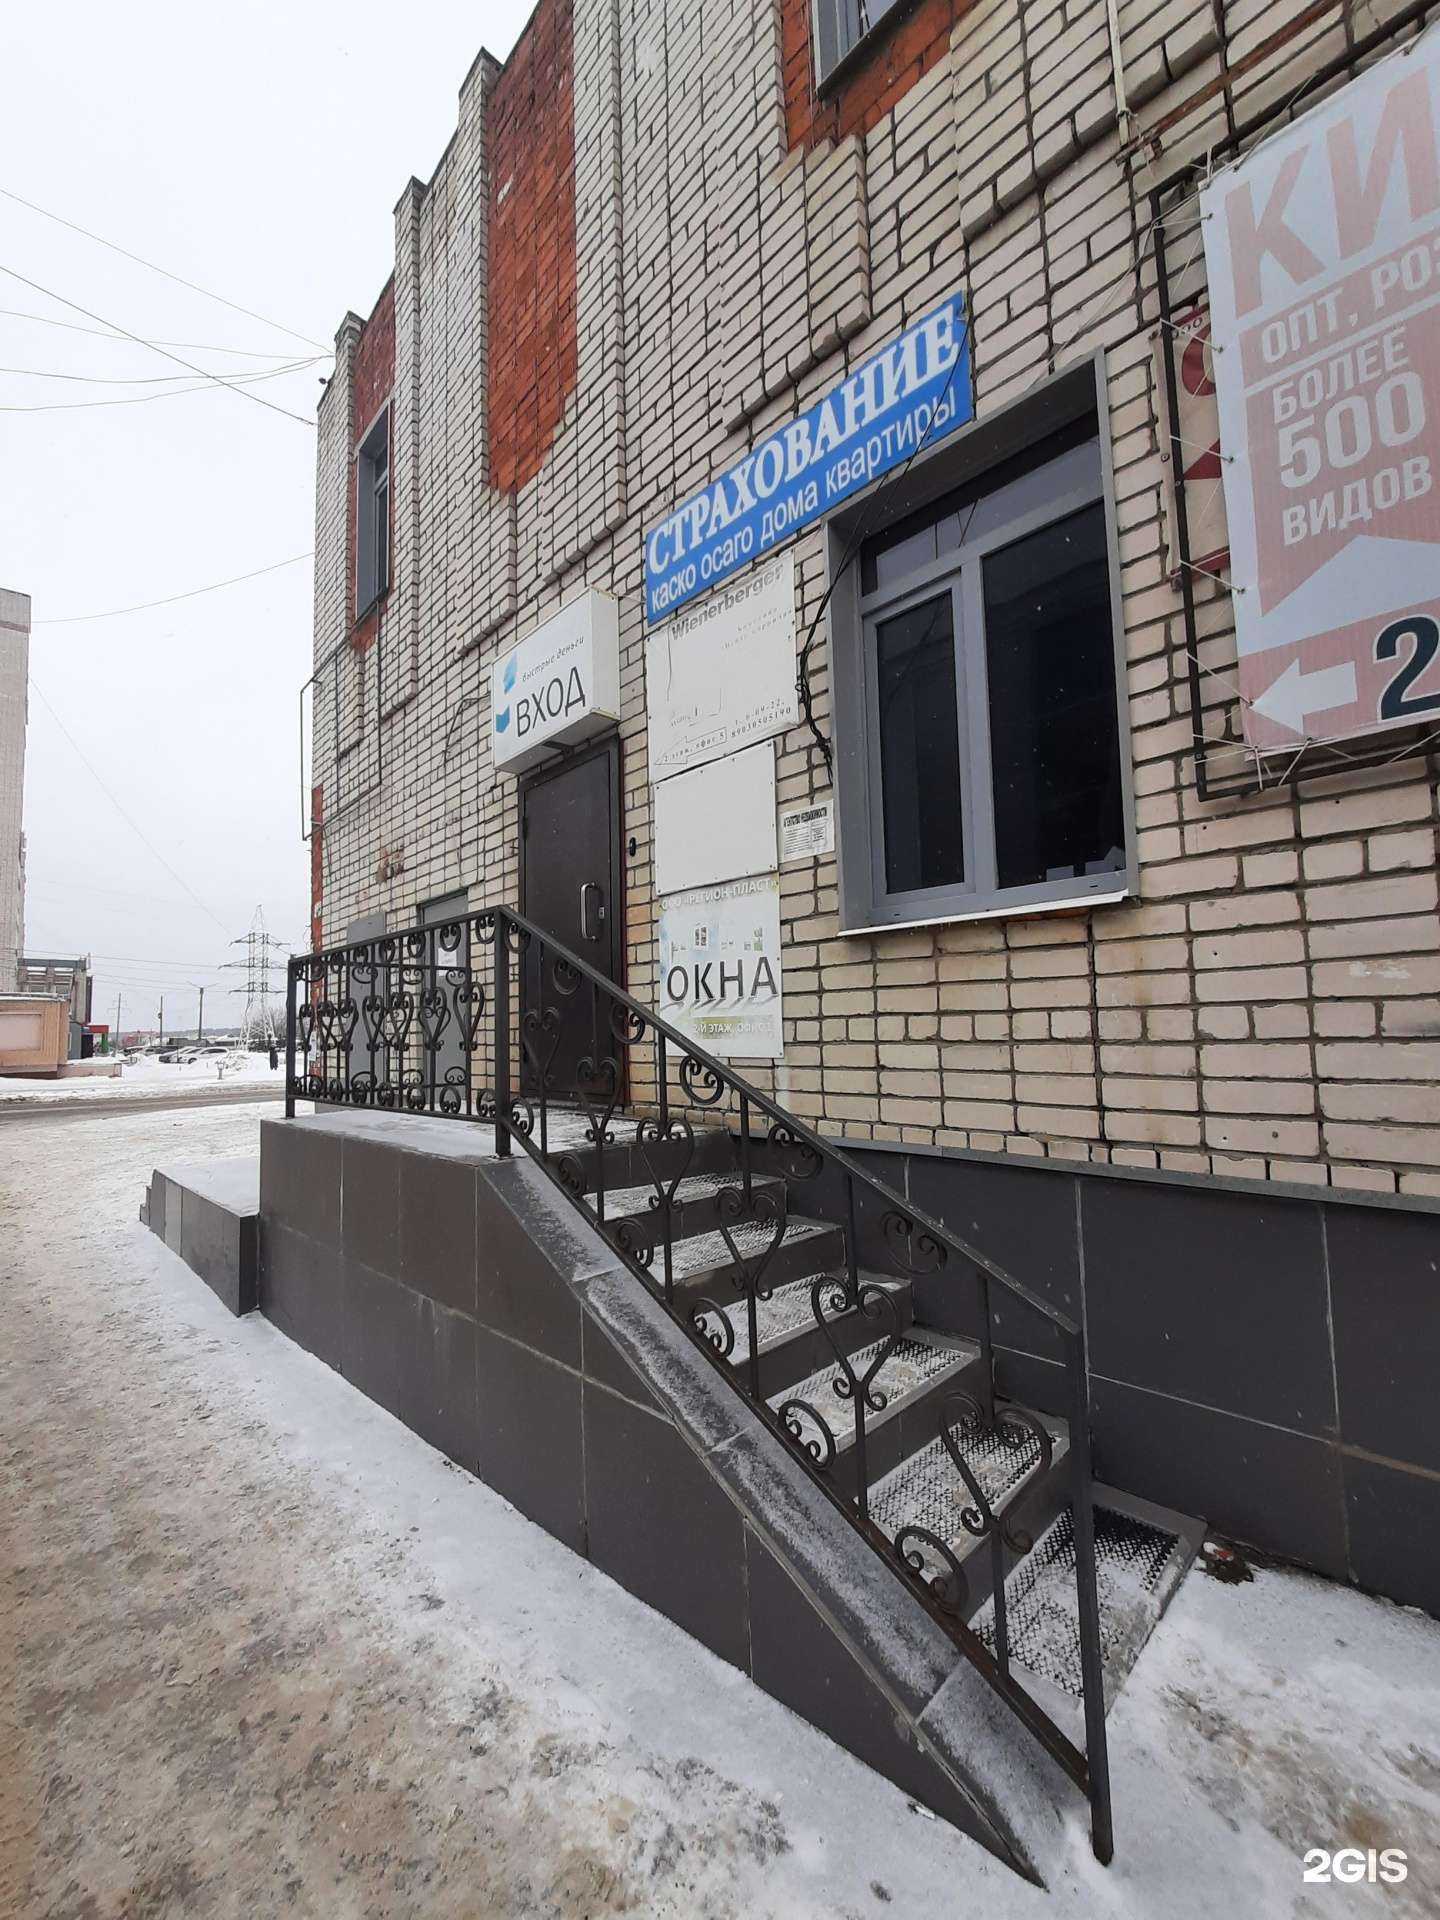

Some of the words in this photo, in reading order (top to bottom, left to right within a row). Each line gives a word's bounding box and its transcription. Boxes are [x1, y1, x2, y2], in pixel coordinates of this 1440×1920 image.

[1224, 66, 1440, 320] КИ
[1272, 326, 1411, 424] БОЛЕЕ
[648, 303, 960, 576] СТРАХОВАНИЕ
[1279, 371, 1427, 489] 500
[651, 568, 696, 614] каско
[701, 527, 753, 580] осаго
[760, 480, 818, 547] дома
[826, 387, 956, 497] квартиры
[1282, 456, 1432, 547] ВИДОВ
[671, 563, 784, 640] Wienerberger
[517, 666, 586, 738] ВХОД
[1373, 614, 1440, 723] 2
[667, 956, 779, 1001] ОКНА
